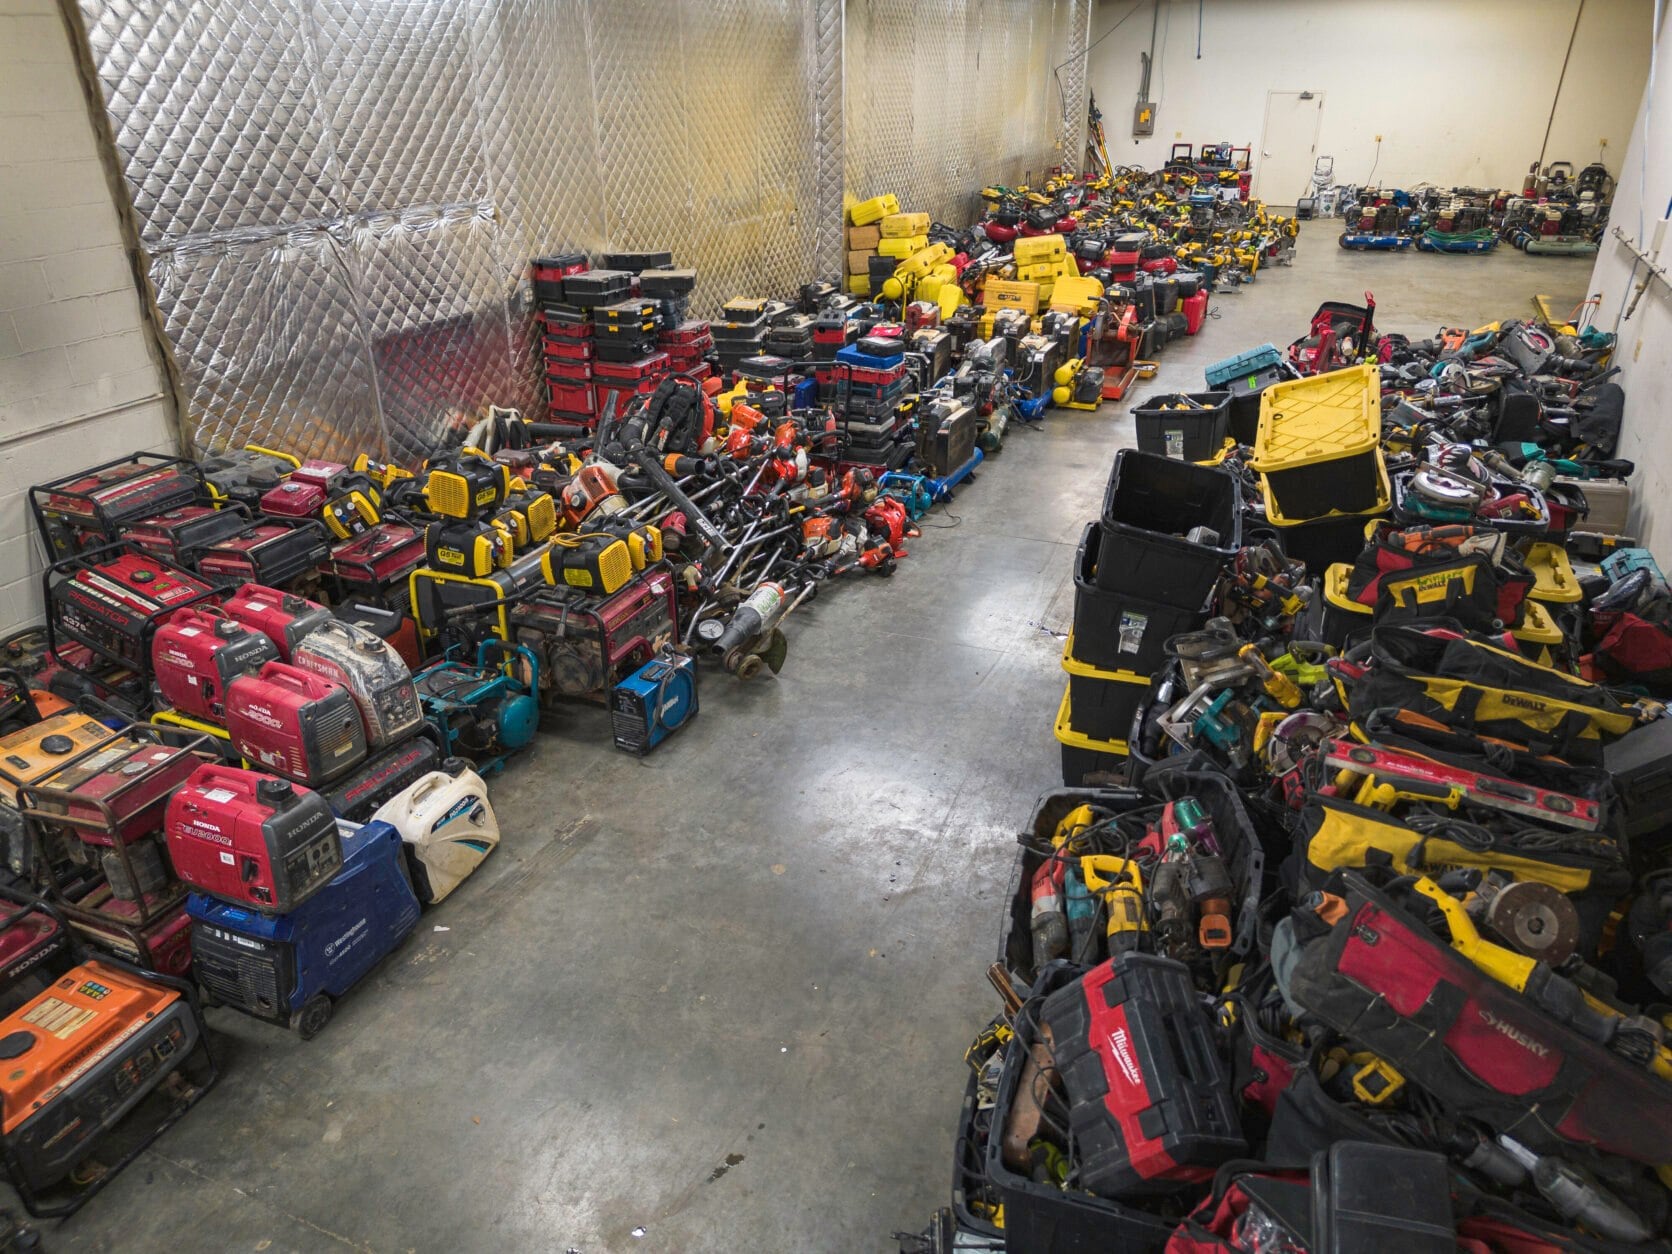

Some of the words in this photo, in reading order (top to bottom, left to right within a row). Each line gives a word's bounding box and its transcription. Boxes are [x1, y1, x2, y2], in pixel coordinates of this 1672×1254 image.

[68, 589, 129, 626] PREDATOR
[234, 644, 269, 663] HONDA
[193, 819, 221, 833] HONDA
[287, 811, 324, 840] HONDA
[334, 917, 367, 947] Westinghouse
[9, 942, 59, 978] HONDA
[1496, 1020, 1550, 1058] HUSKY
[1111, 1027, 1141, 1085] Milwaukee
